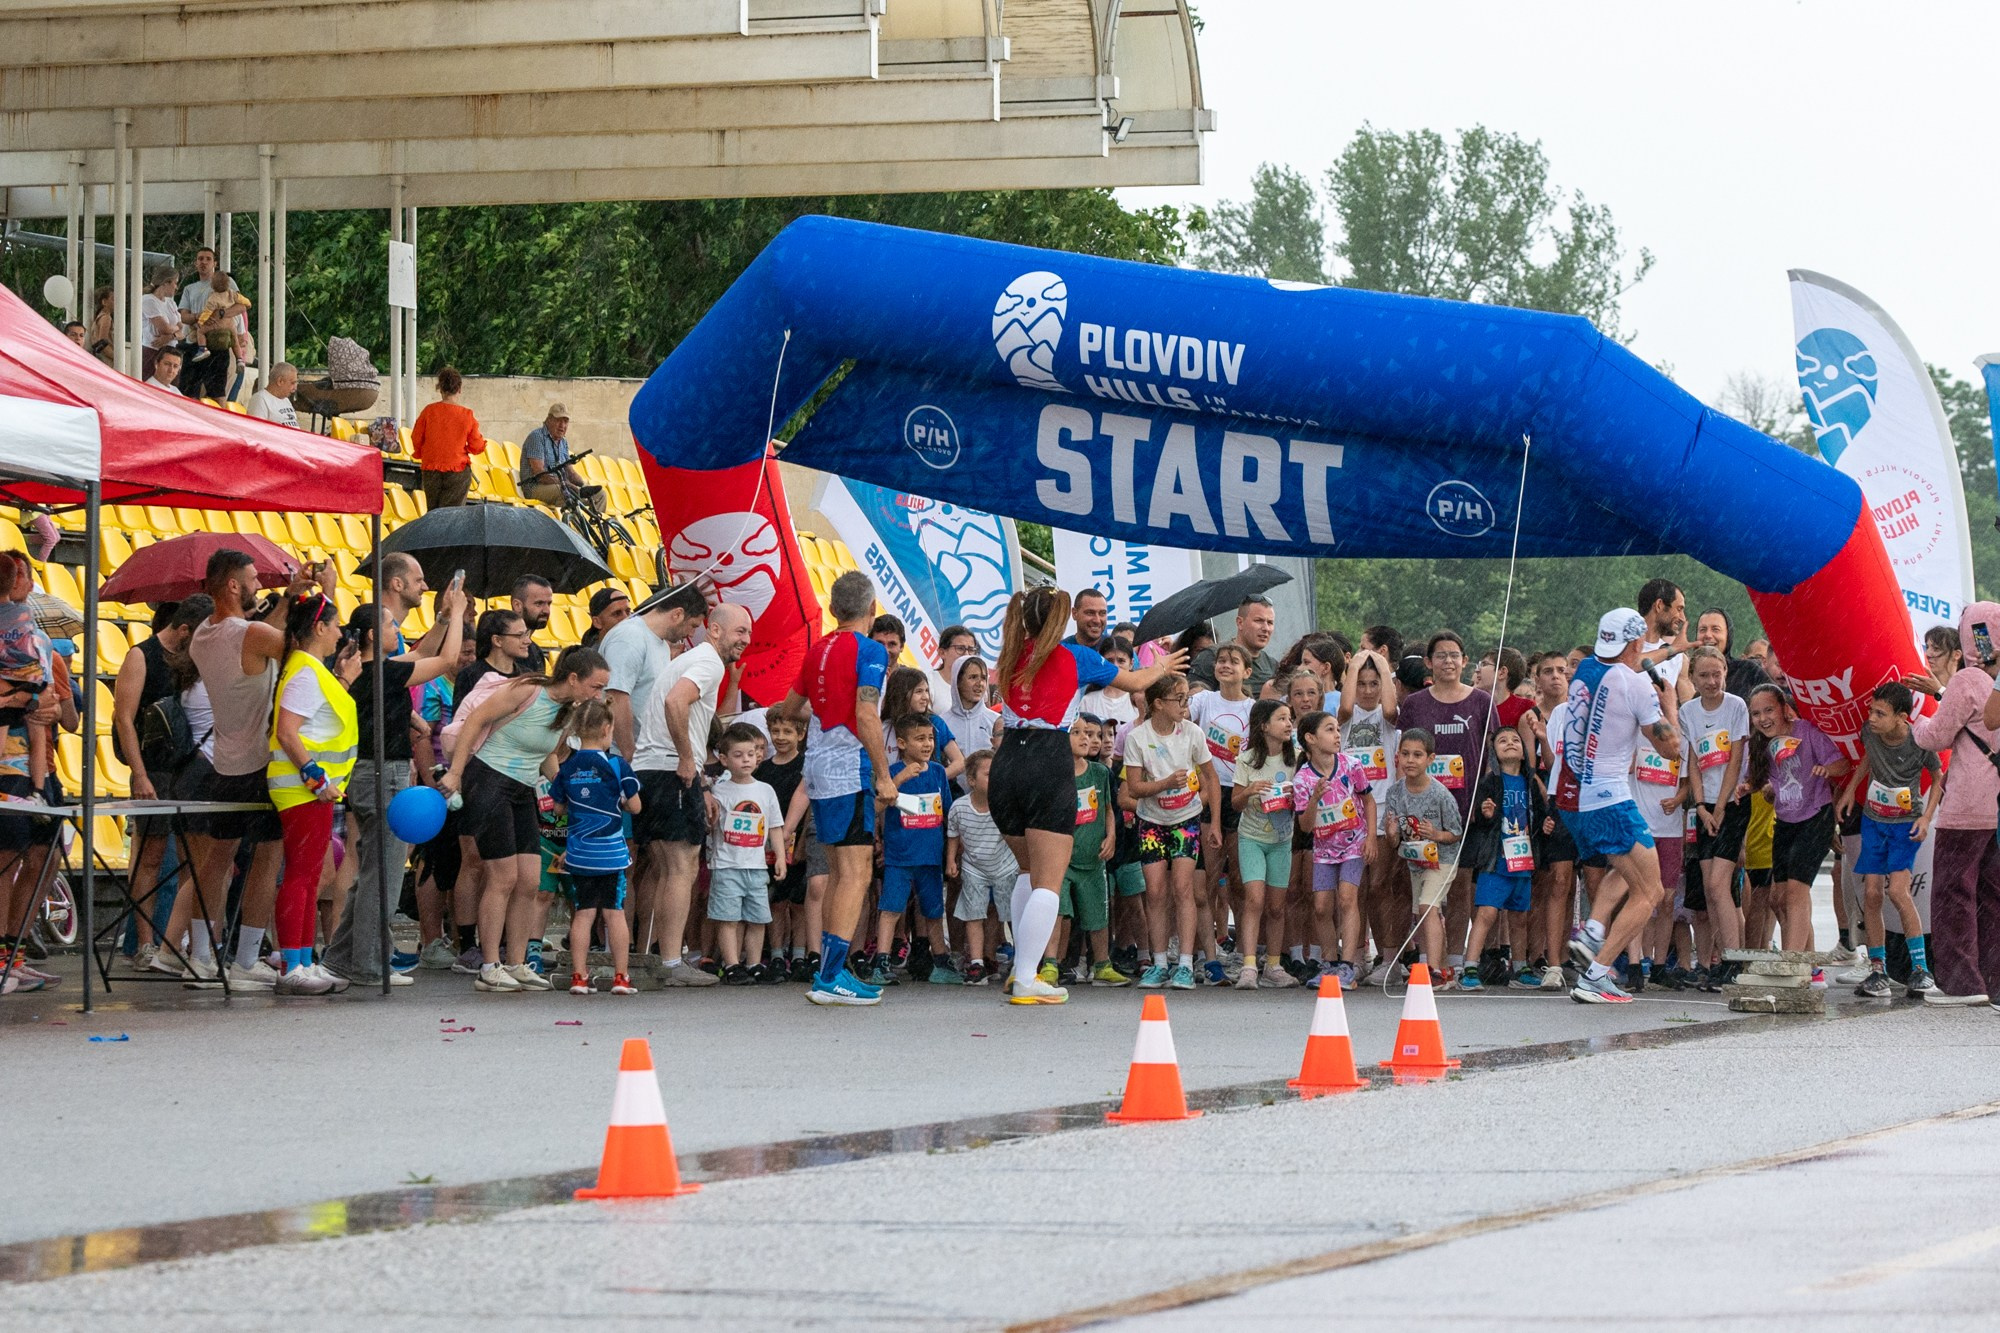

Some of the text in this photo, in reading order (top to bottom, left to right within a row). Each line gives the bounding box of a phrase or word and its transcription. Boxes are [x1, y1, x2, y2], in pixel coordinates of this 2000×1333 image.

[1079, 322, 1246, 386] PLOVDIV
[1084, 374, 1227, 411] HILLS IN
[1210, 406, 1320, 428] MARKOVO
[913, 423, 950, 448] P/H
[1035, 403, 1345, 545] START
[1437, 500, 1483, 520] P/H
[1591, 685, 1609, 735] MATTERS
[1207, 726, 1226, 745] 106
[1434, 723, 1464, 735] PUMA
[1587, 733, 1599, 760] STEP
[1699, 741, 1710, 754] 48
[1644, 754, 1662, 768] 46
[1875, 790, 1889, 804] 16
[733, 818, 752, 832] 82
[1321, 811, 1336, 824] 11
[1403, 848, 1419, 859] 60
[1512, 843, 1529, 856] 39
[832, 984, 858, 998] HOKA
